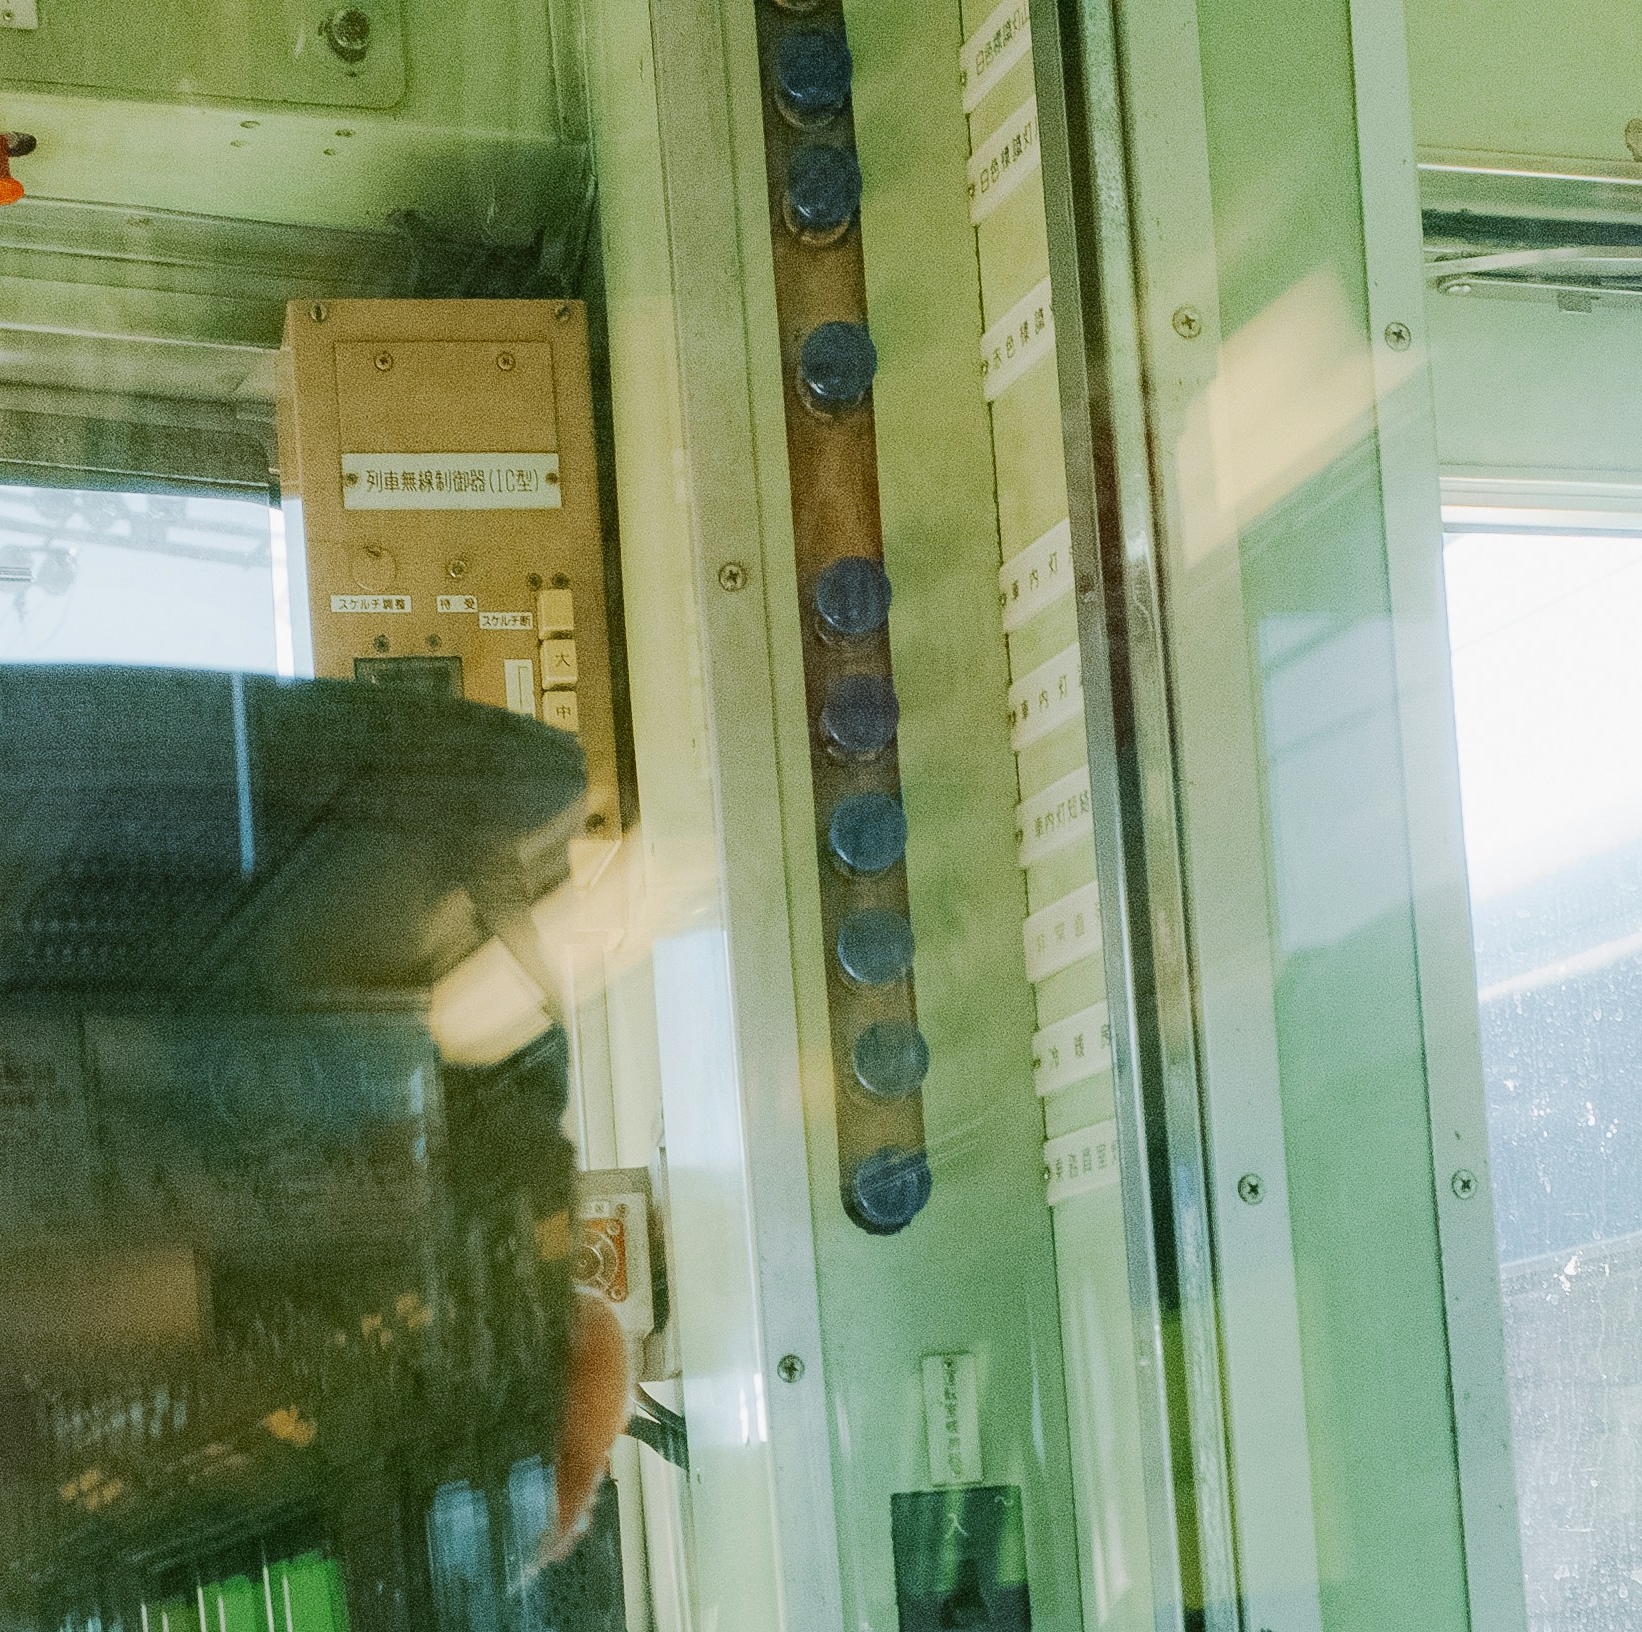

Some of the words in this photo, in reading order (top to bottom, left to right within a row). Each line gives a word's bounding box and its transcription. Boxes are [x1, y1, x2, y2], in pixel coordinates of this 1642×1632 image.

[366, 468, 540, 494] 列車無線制御器(IC型)
[1011, 546, 1073, 602] 車内灯
[337, 597, 406, 611] スケルチ調整
[554, 651, 571, 668] 大
[1021, 668, 1082, 720] 車内灯
[555, 704, 573, 721] 中
